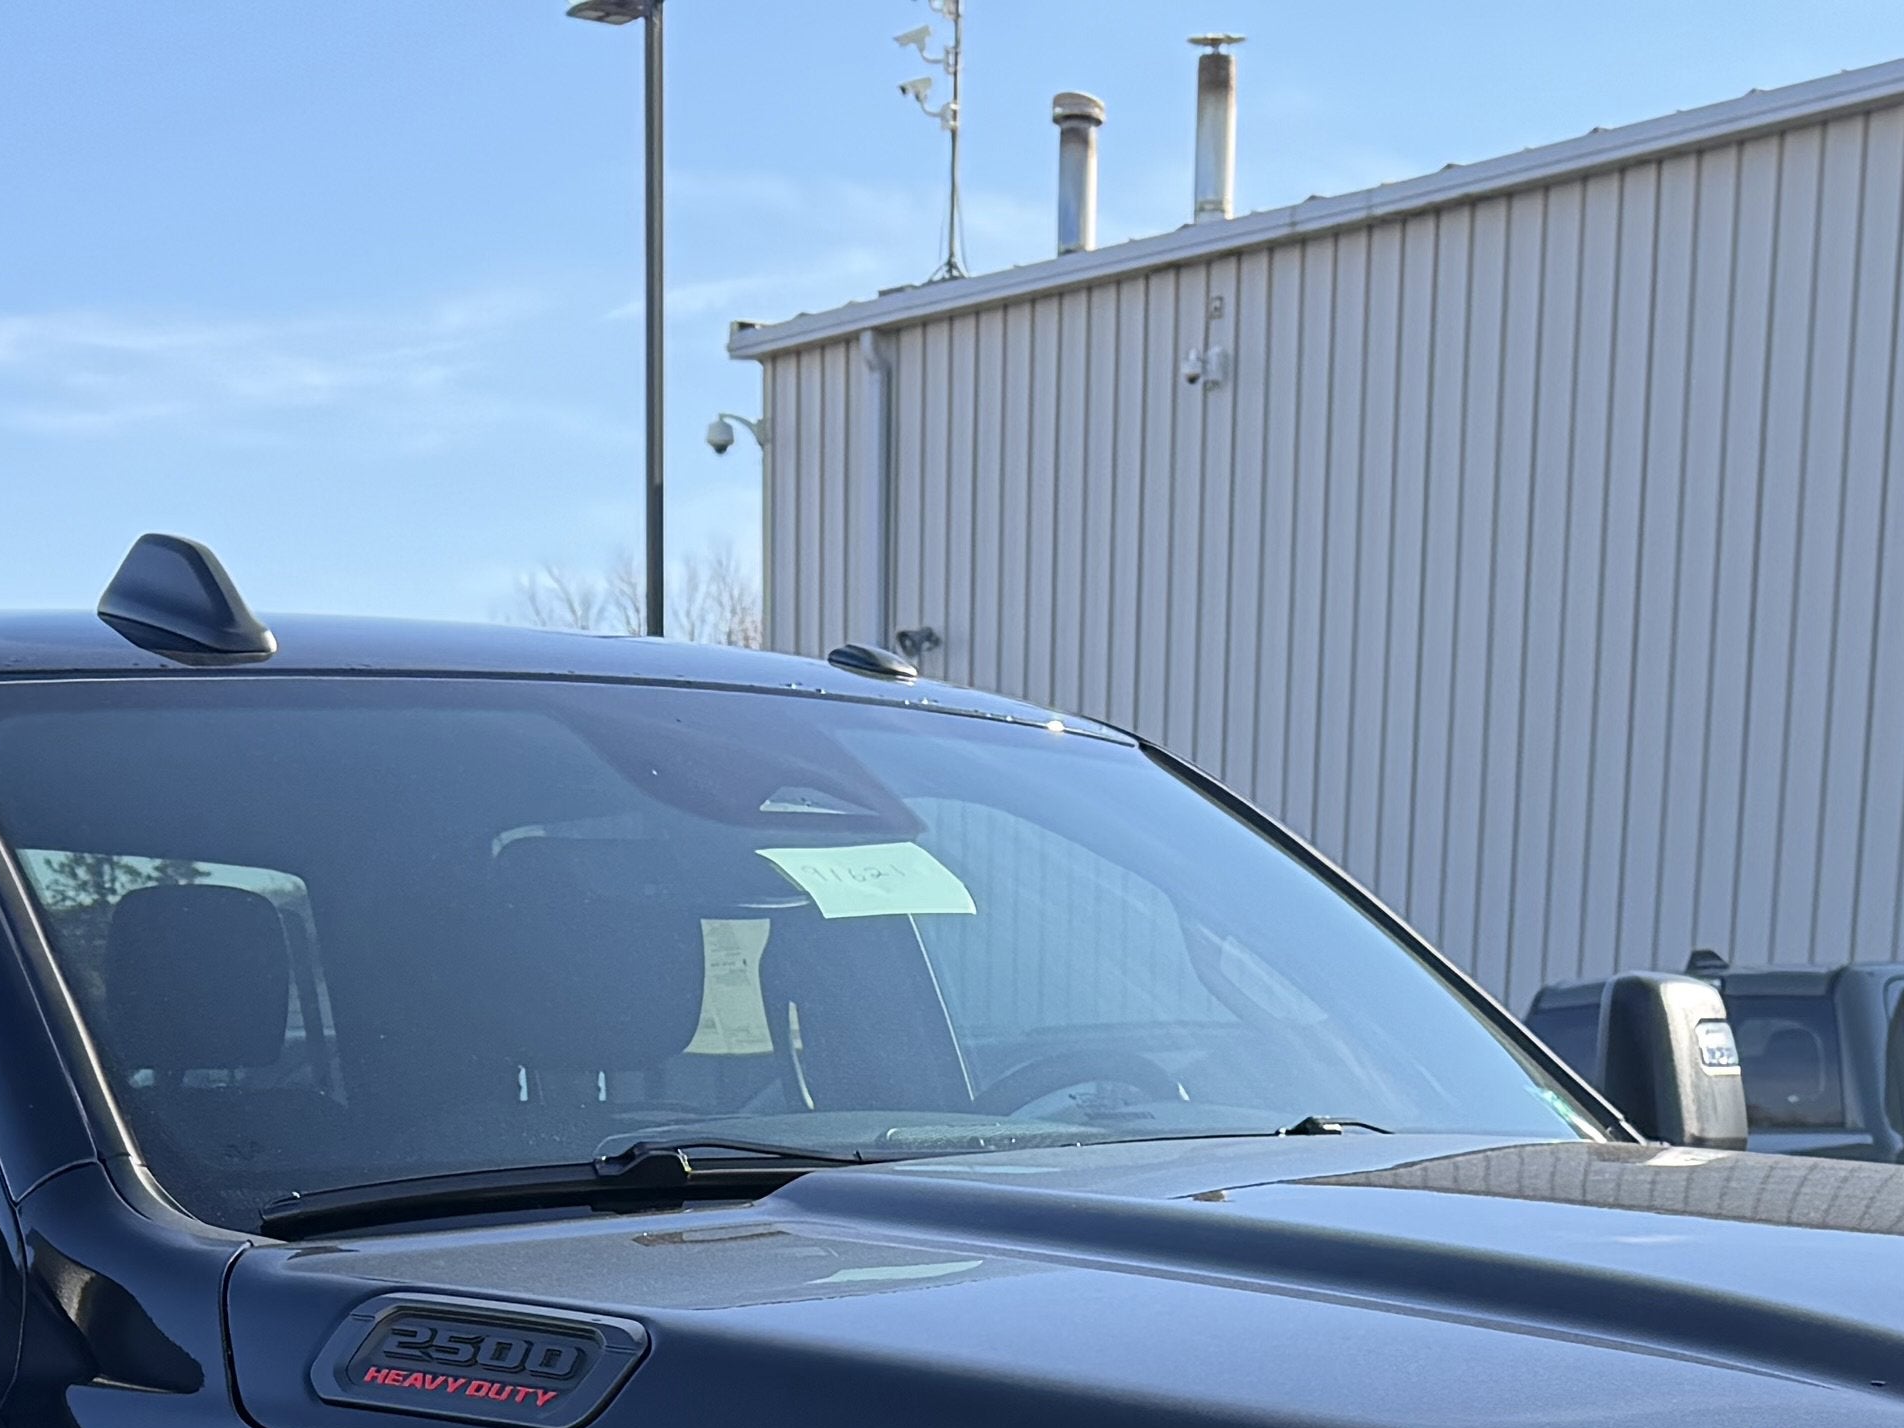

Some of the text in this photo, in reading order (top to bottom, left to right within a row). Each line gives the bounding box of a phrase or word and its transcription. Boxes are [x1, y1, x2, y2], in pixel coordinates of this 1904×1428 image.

[383, 1325, 583, 1379] 2500
[363, 1366, 559, 1408] HEAVY DUTY
